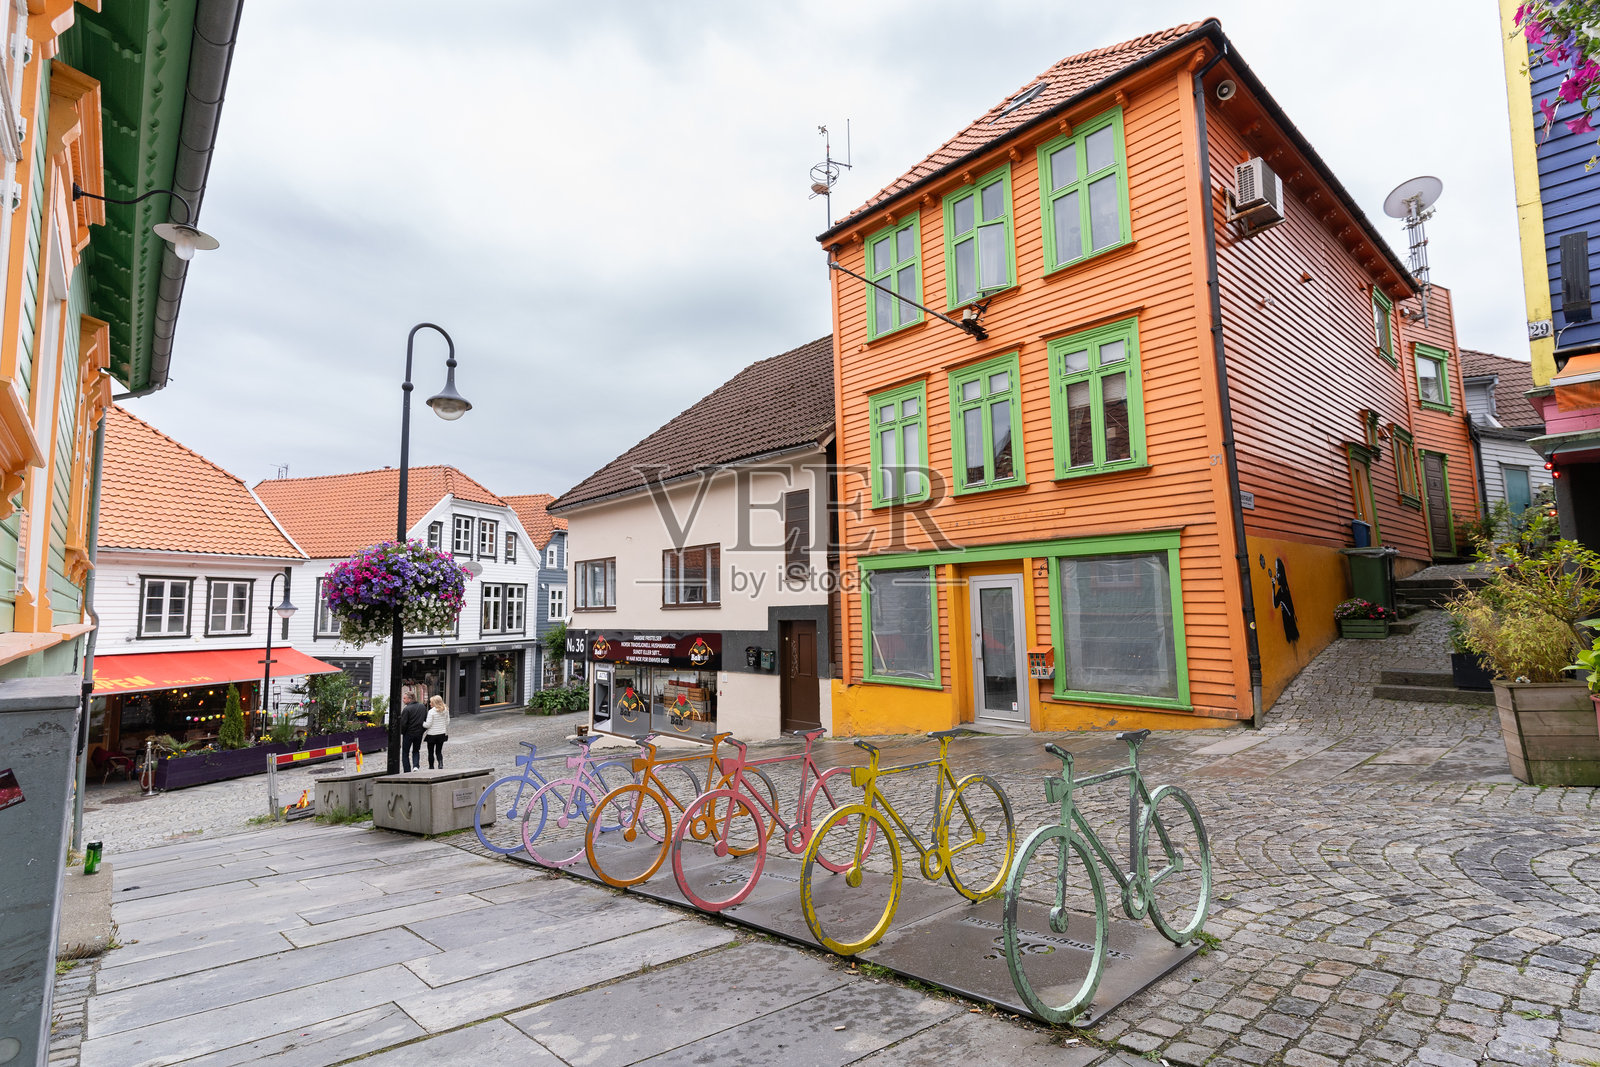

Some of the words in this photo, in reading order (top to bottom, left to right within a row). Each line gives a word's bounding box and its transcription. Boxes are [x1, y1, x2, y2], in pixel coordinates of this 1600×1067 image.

[1530, 322, 1550, 337] 29
[1209, 453, 1223, 466] 31
[575, 638, 585, 653] 36
